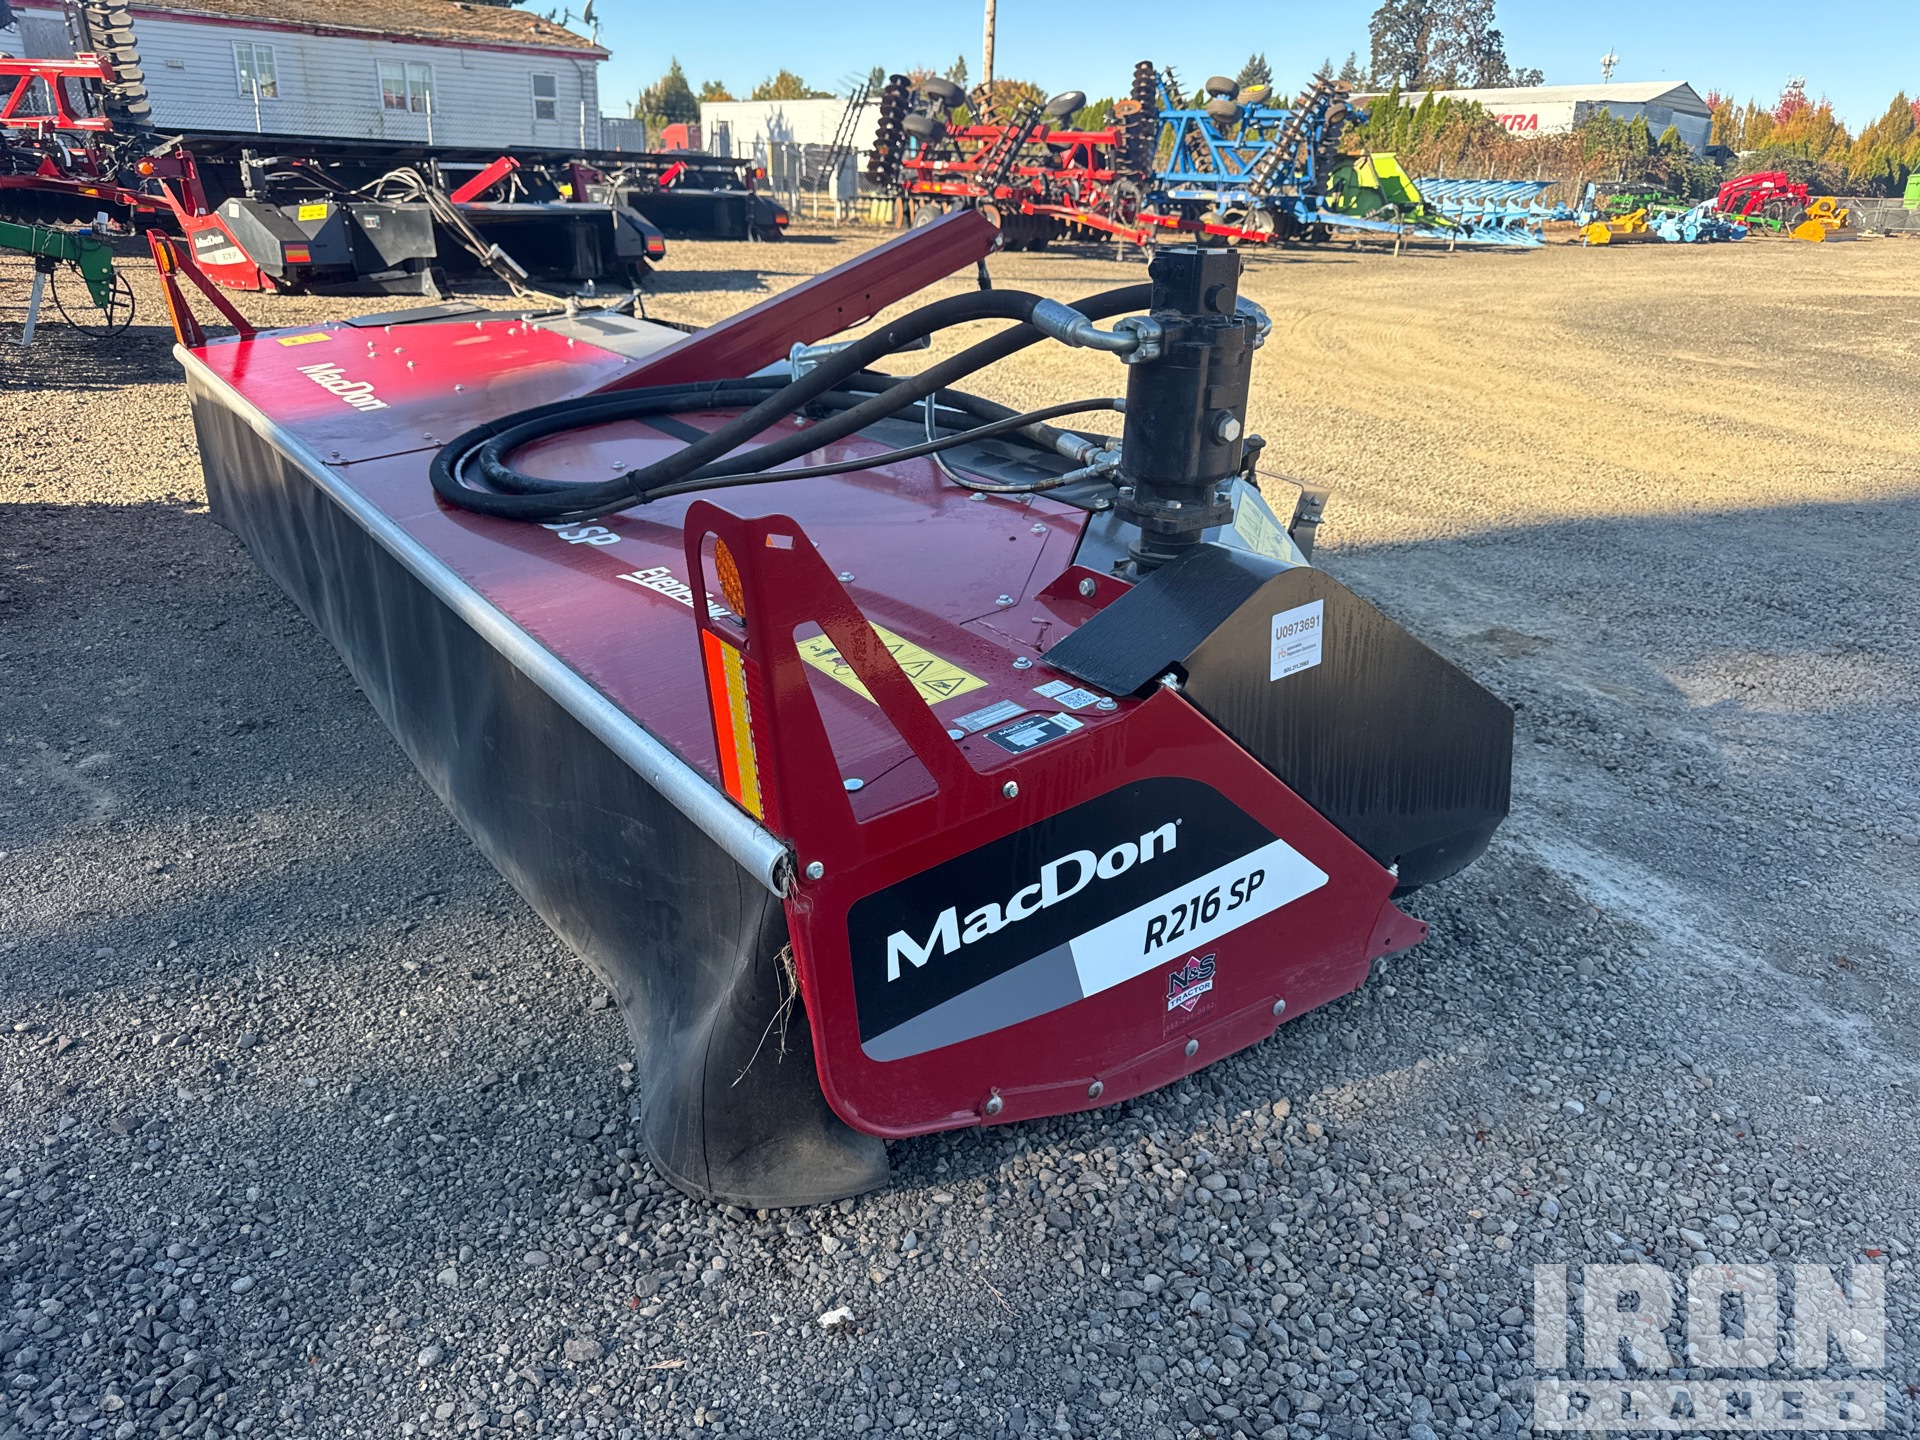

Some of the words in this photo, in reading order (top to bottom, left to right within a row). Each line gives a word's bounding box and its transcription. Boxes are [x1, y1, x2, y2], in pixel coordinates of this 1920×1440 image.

[1494, 113, 1538, 131] TRA
[296, 362, 389, 411] MacDon
[558, 525, 622, 546] SP
[1275, 614, 1320, 641] U0973691
[887, 821, 1178, 983] MacDon
[1143, 886, 1221, 956] R216
[1226, 869, 1266, 913] SP
[1166, 953, 1216, 1000] N&S
[1169, 982, 1212, 1007] TRACTOR
